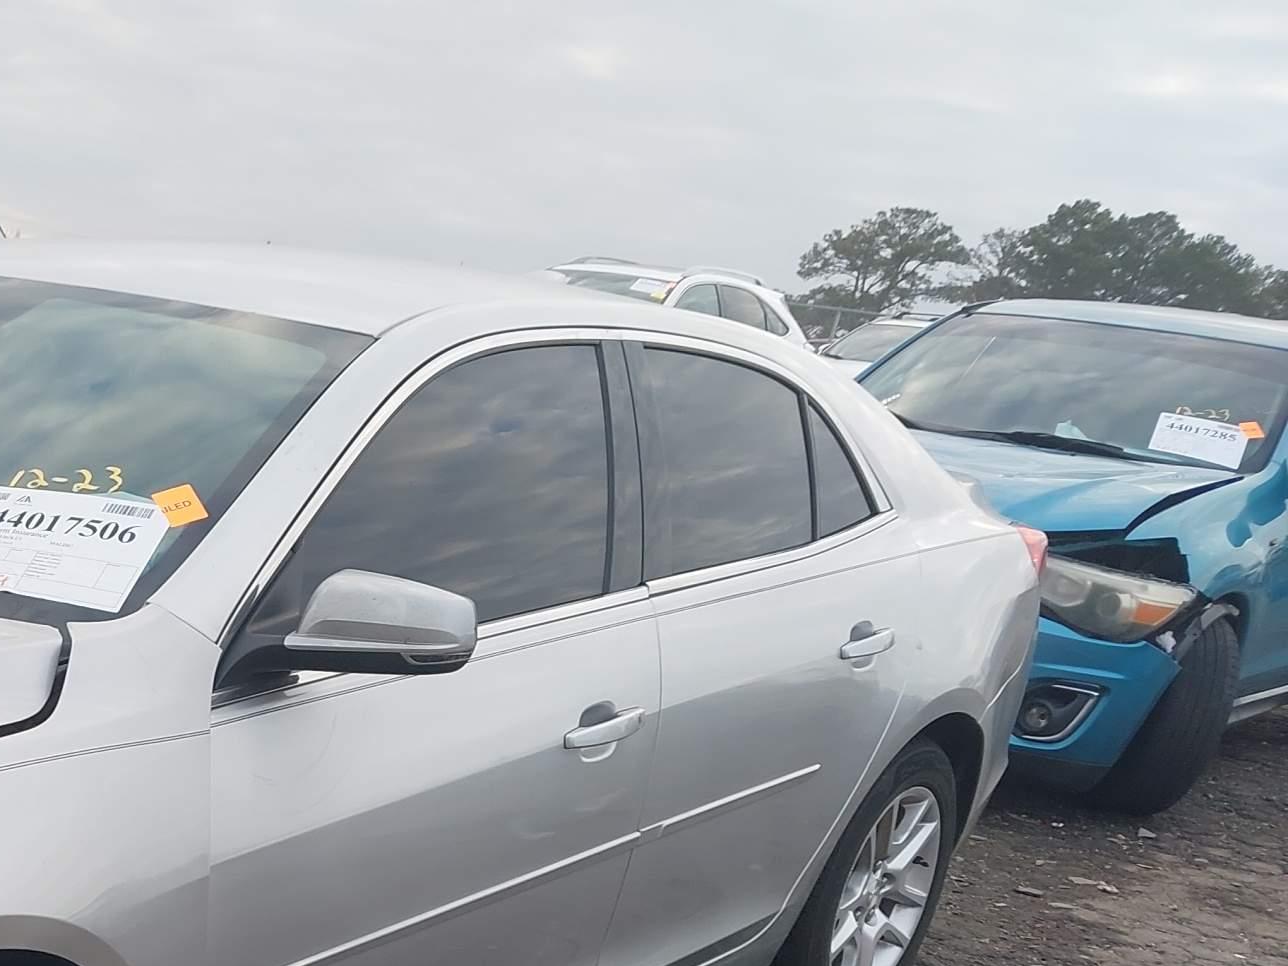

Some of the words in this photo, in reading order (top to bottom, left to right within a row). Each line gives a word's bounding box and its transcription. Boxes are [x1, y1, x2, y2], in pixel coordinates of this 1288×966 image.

[1166, 421, 1238, 442] 44017285
[9, 465, 126, 494] 12-23
[11, 528, 50, 539] Insurance
